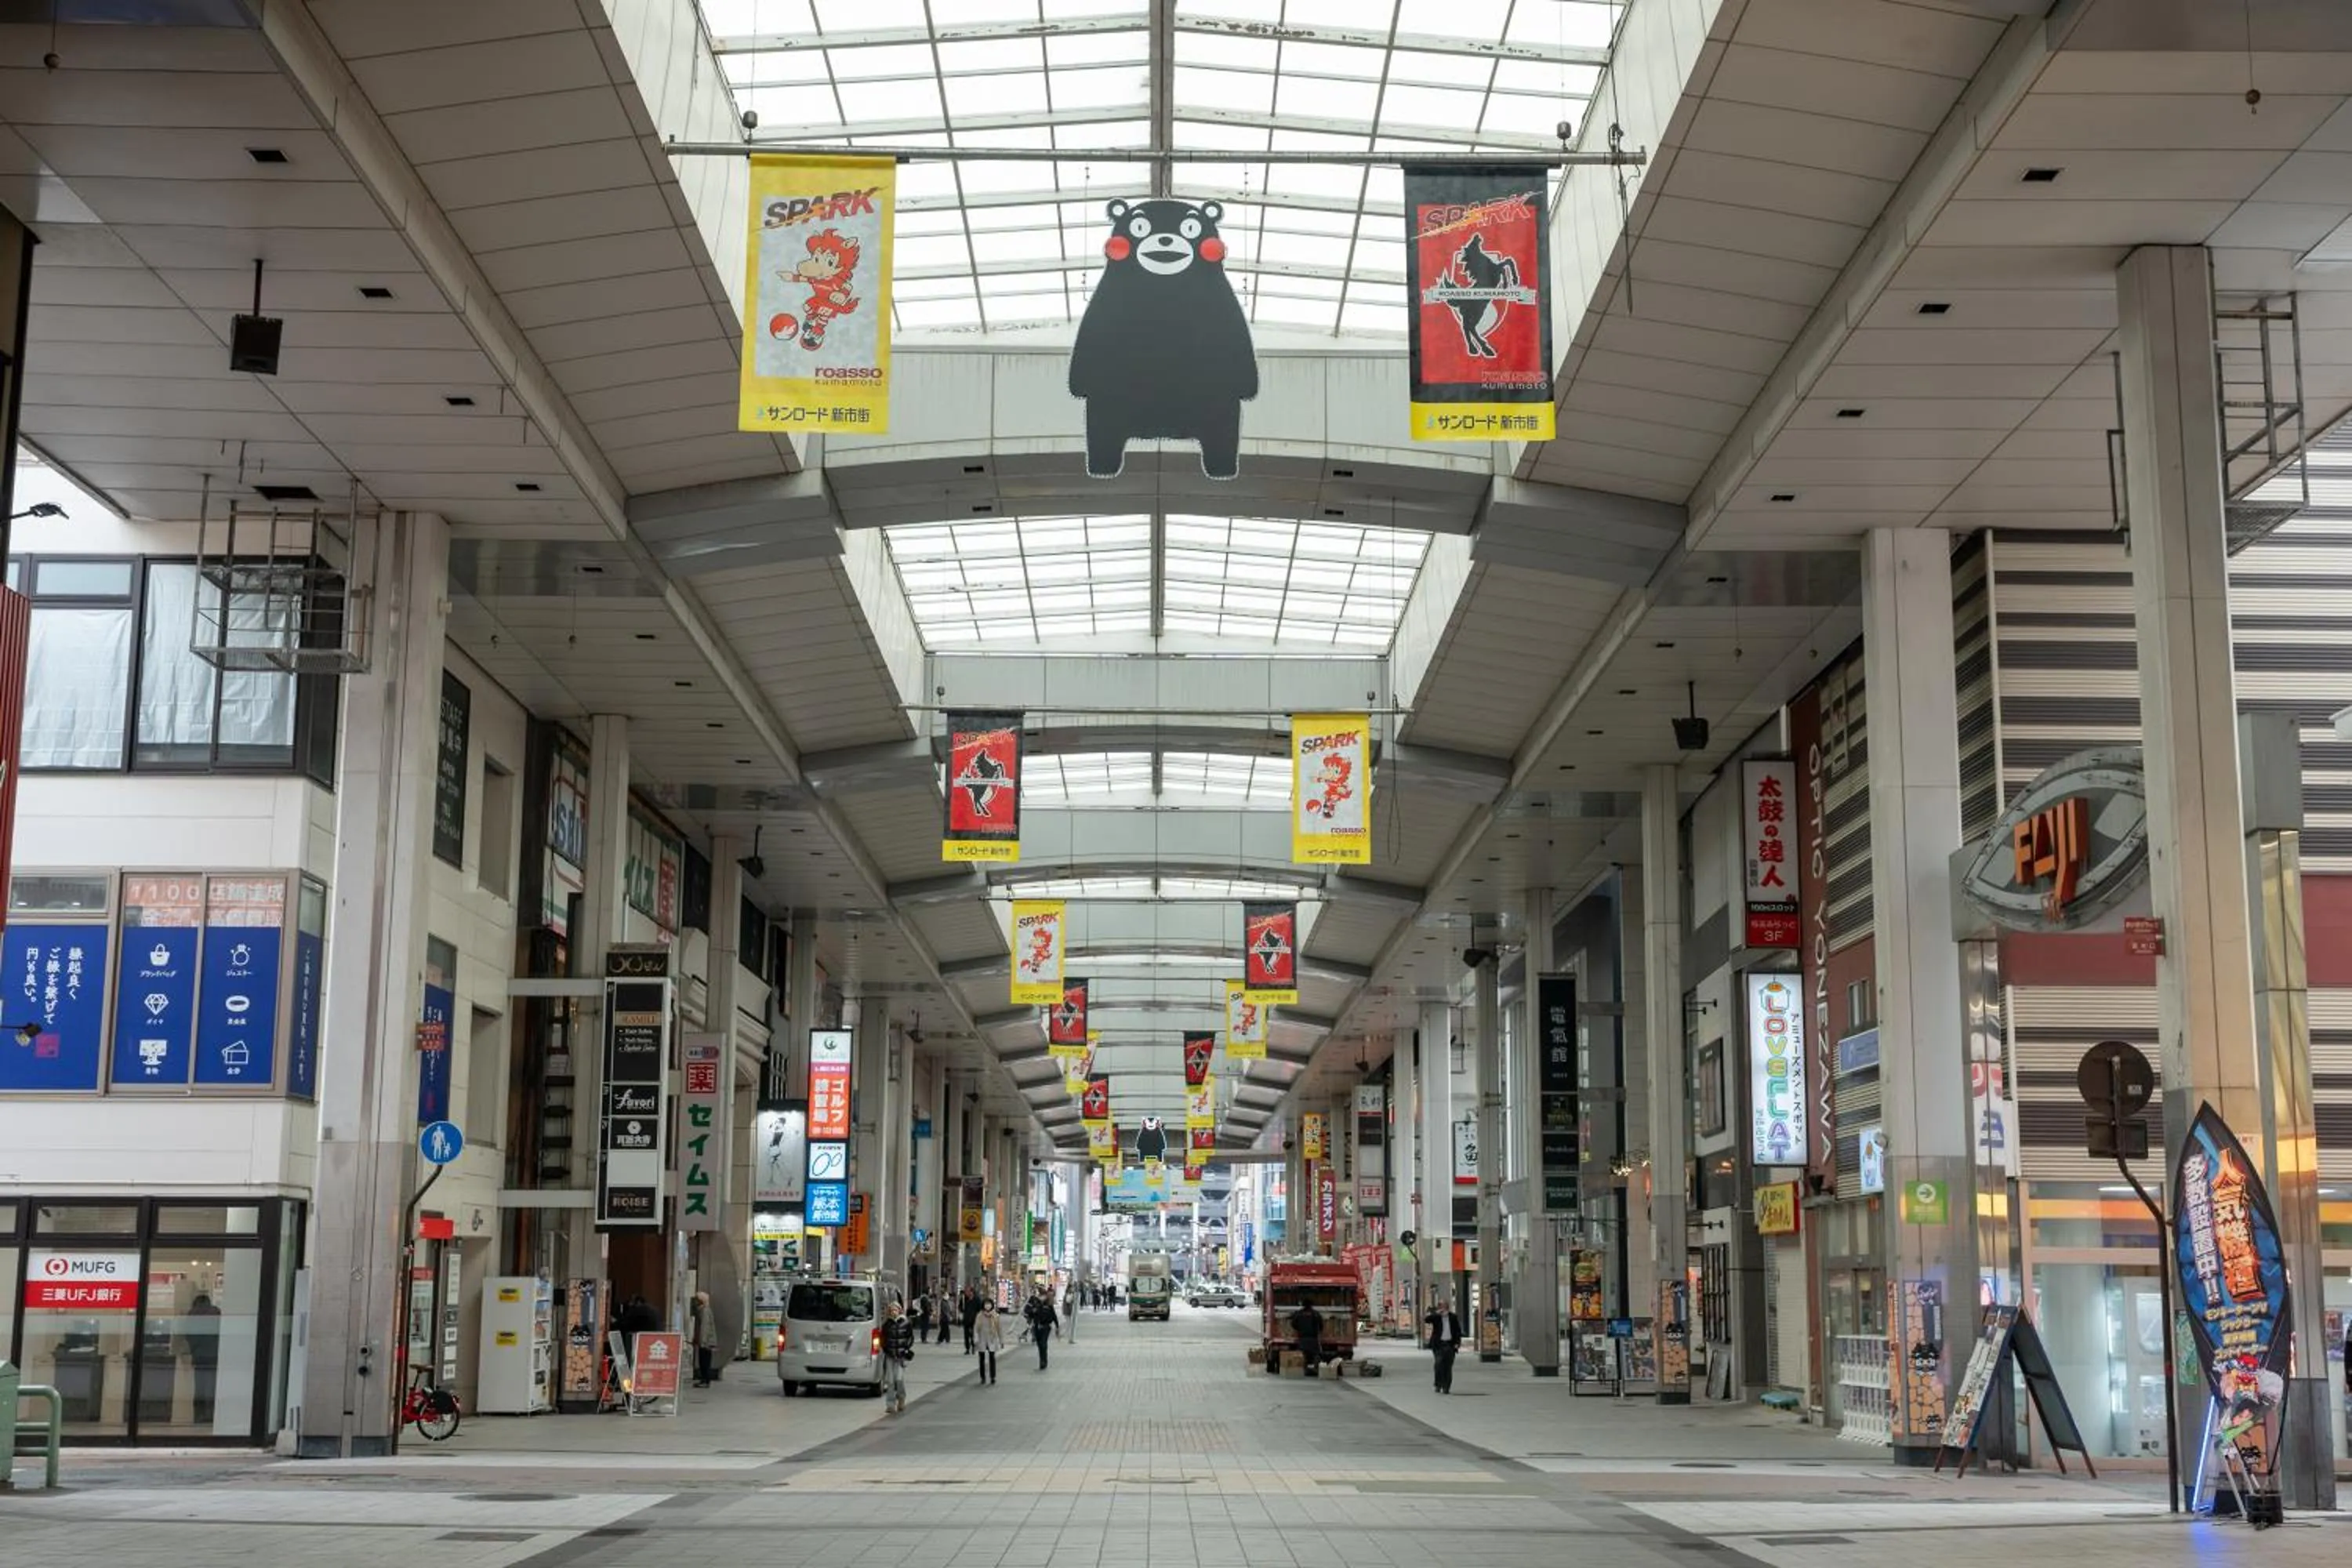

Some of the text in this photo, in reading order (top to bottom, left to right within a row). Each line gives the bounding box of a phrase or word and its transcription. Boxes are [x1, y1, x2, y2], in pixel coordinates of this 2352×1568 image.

[764, 188, 877, 227] SPARK
[815, 365, 883, 379] roasso
[768, 406, 869, 423] サンロード 新市街
[1438, 415, 1539, 430] サンロード 新市街
[1301, 730, 1360, 754] SPARK
[1757, 775, 1785, 889] 太鼓の達人
[131, 884, 200, 901] 1100
[1018, 912, 1059, 929] SPARK
[1763, 931, 1783, 942] 3F
[689, 1065, 713, 1091] 薬
[1791, 1013, 1803, 1145] アミューズメントスポット
[831, 1078, 845, 1123] ゴルフ
[684, 1103, 713, 1215] セイムス
[1321, 1180, 1334, 1232] カラオケ
[2211, 1147, 2263, 1300] 人気機種
[71, 1261, 115, 1274] MUFG
[42, 1288, 122, 1302] 三菱UFJ銀行
